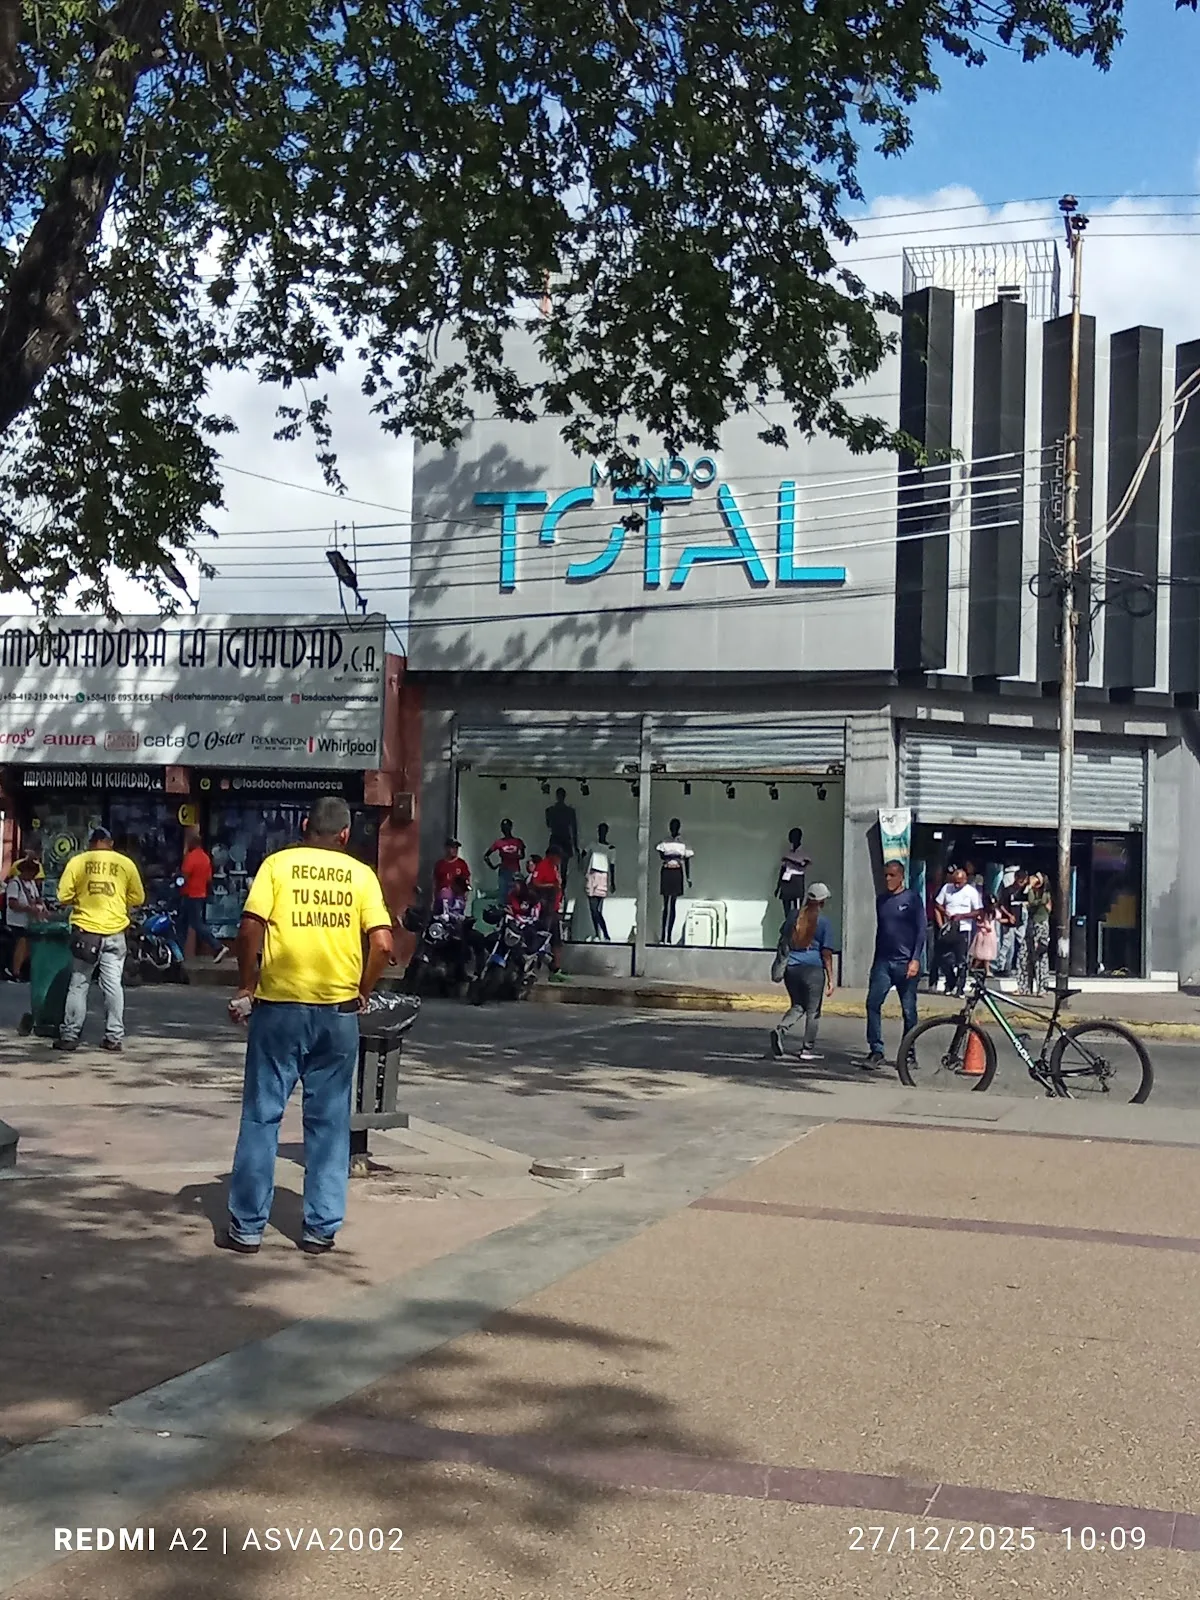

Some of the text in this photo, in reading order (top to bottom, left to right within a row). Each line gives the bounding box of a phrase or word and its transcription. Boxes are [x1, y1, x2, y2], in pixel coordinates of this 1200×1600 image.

[591, 456, 716, 484] MNDO
[473, 481, 847, 592] TOTAL
[179, 628, 207, 668] LA
[351, 645, 380, 673] C.A.
[143, 734, 185, 747] cata
[204, 730, 246, 751] Oster
[317, 735, 378, 757] Whirlpool
[23, 770, 88, 788] IMPORTADORA
[91, 772, 103, 788] LA
[291, 865, 352, 884] RECARGA
[293, 888, 353, 907] TU SALDO
[291, 911, 351, 928] LLAMADAS
